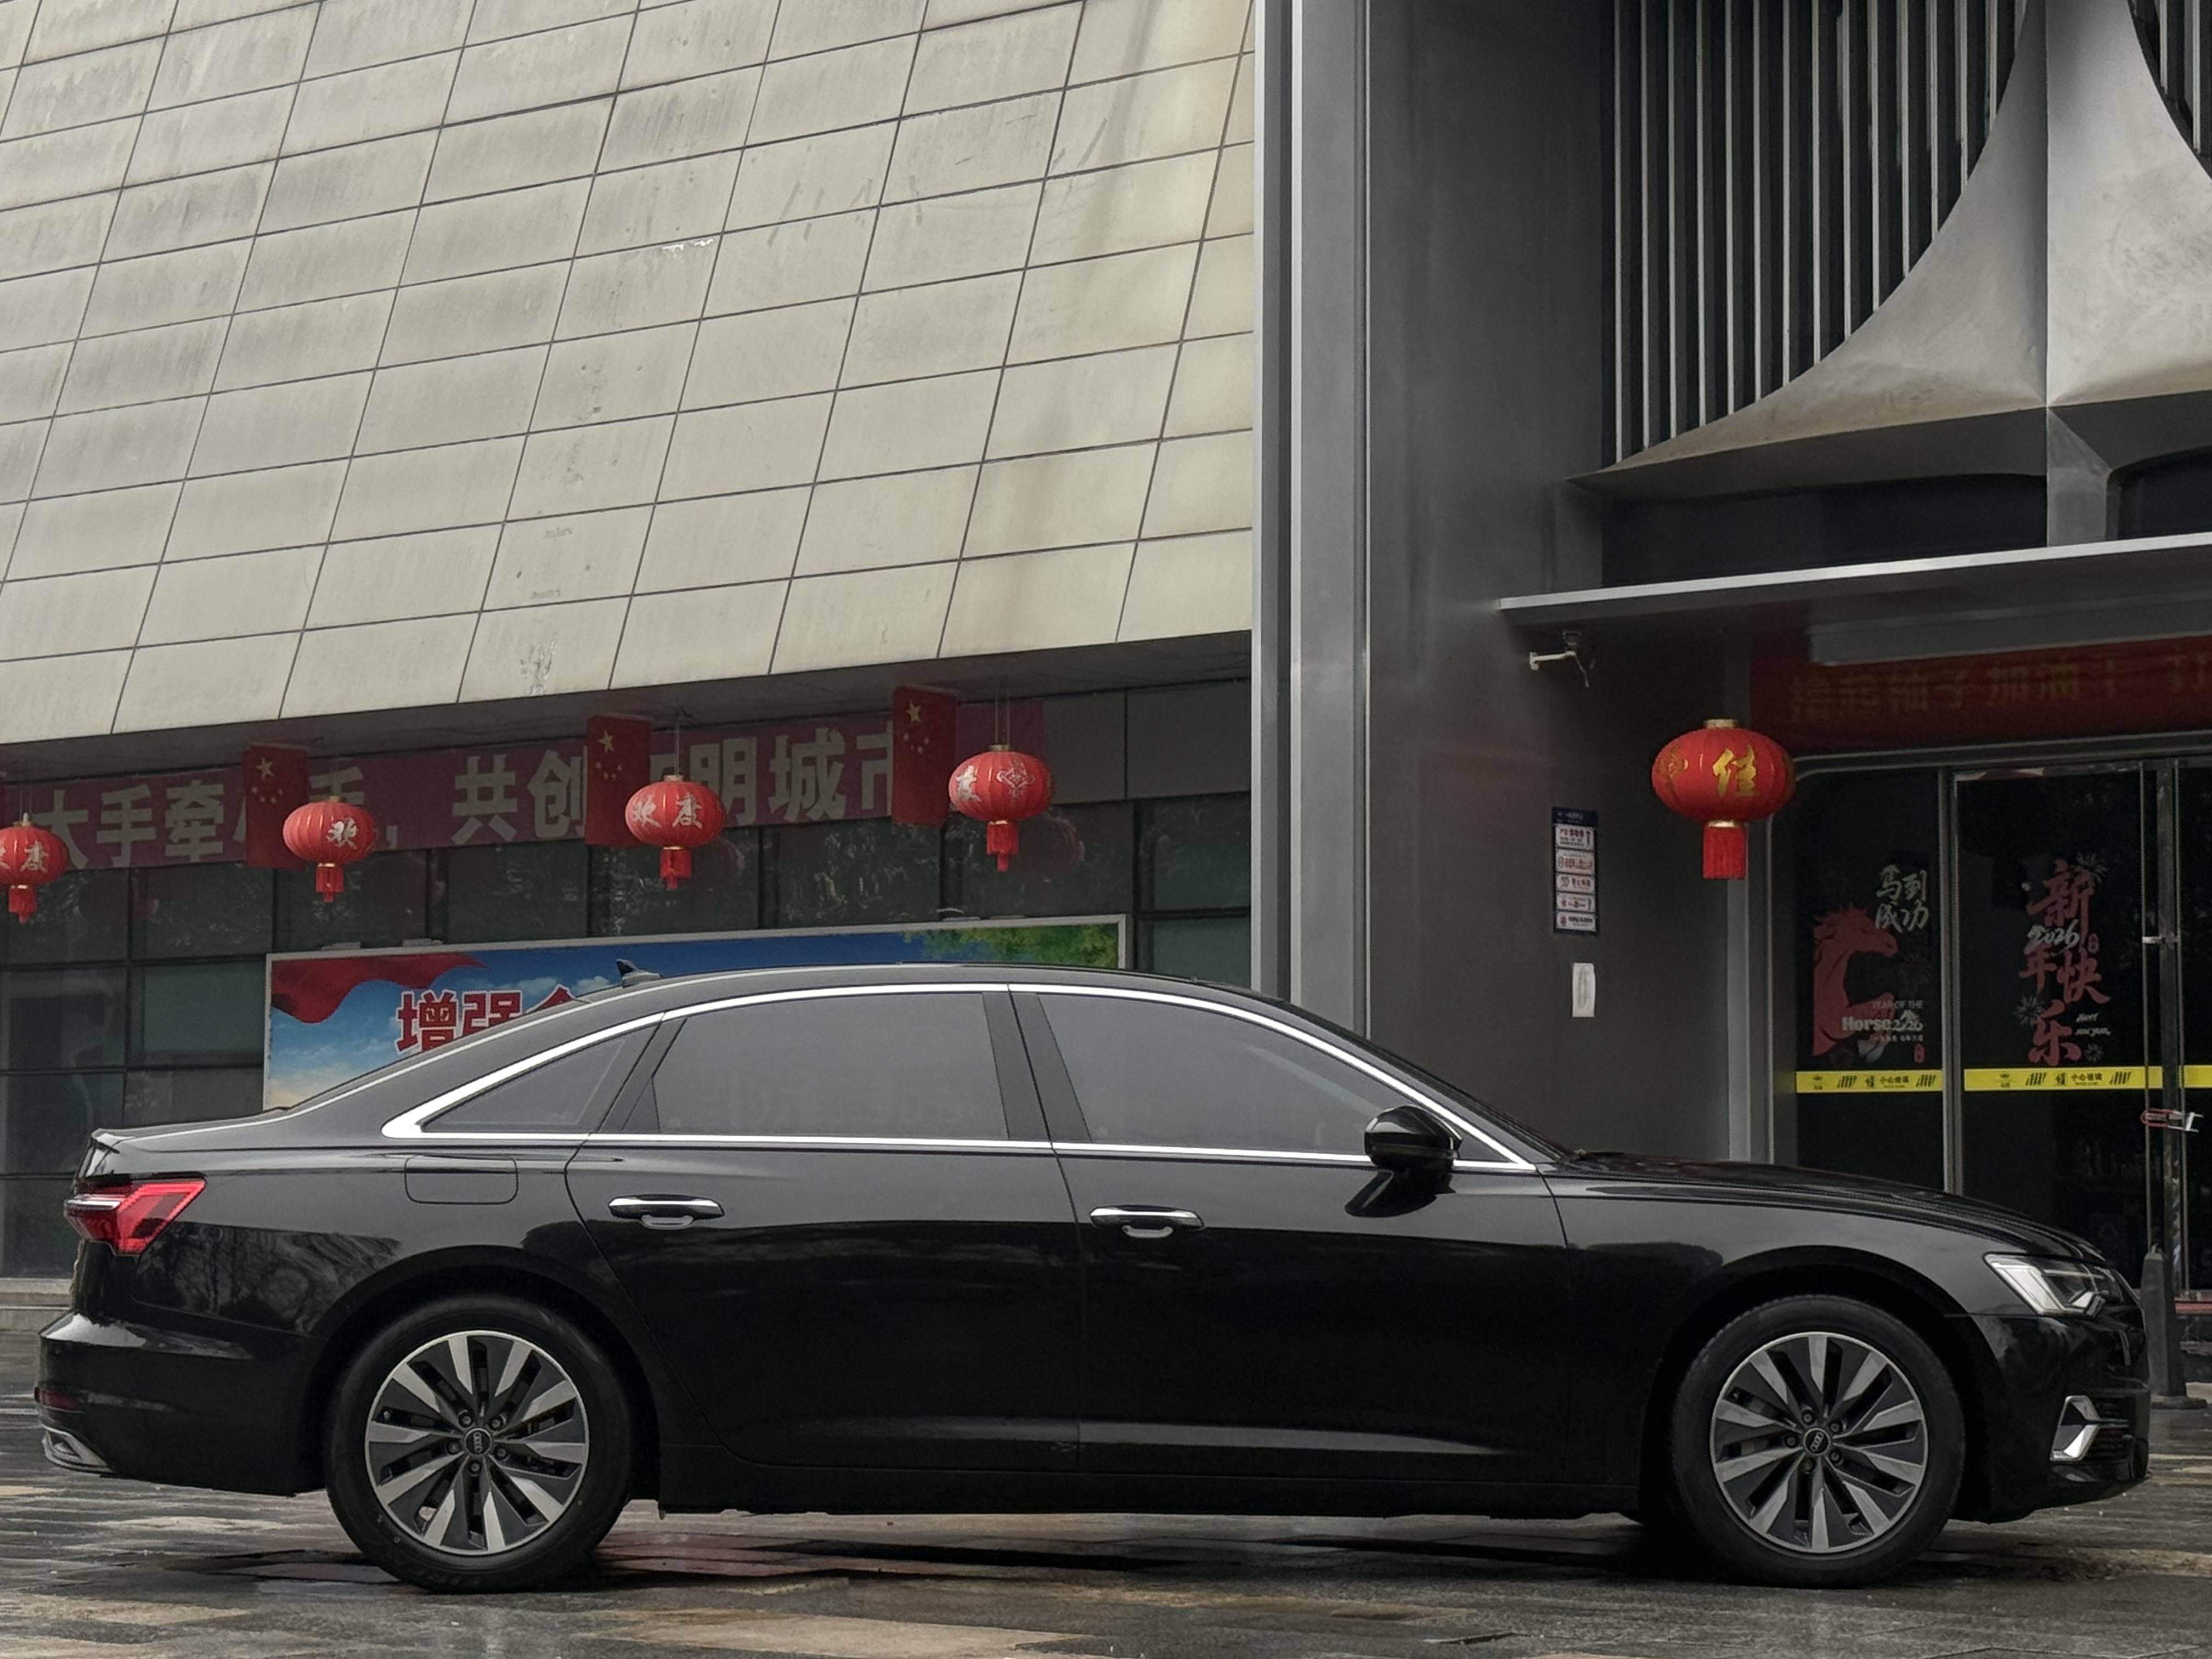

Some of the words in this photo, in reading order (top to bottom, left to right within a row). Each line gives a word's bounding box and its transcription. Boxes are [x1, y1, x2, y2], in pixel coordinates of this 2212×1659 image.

[1712, 744, 1759, 798] 佳
[394, 984, 576, 1054] 增强
[1841, 1015, 1891, 1032] Horse
